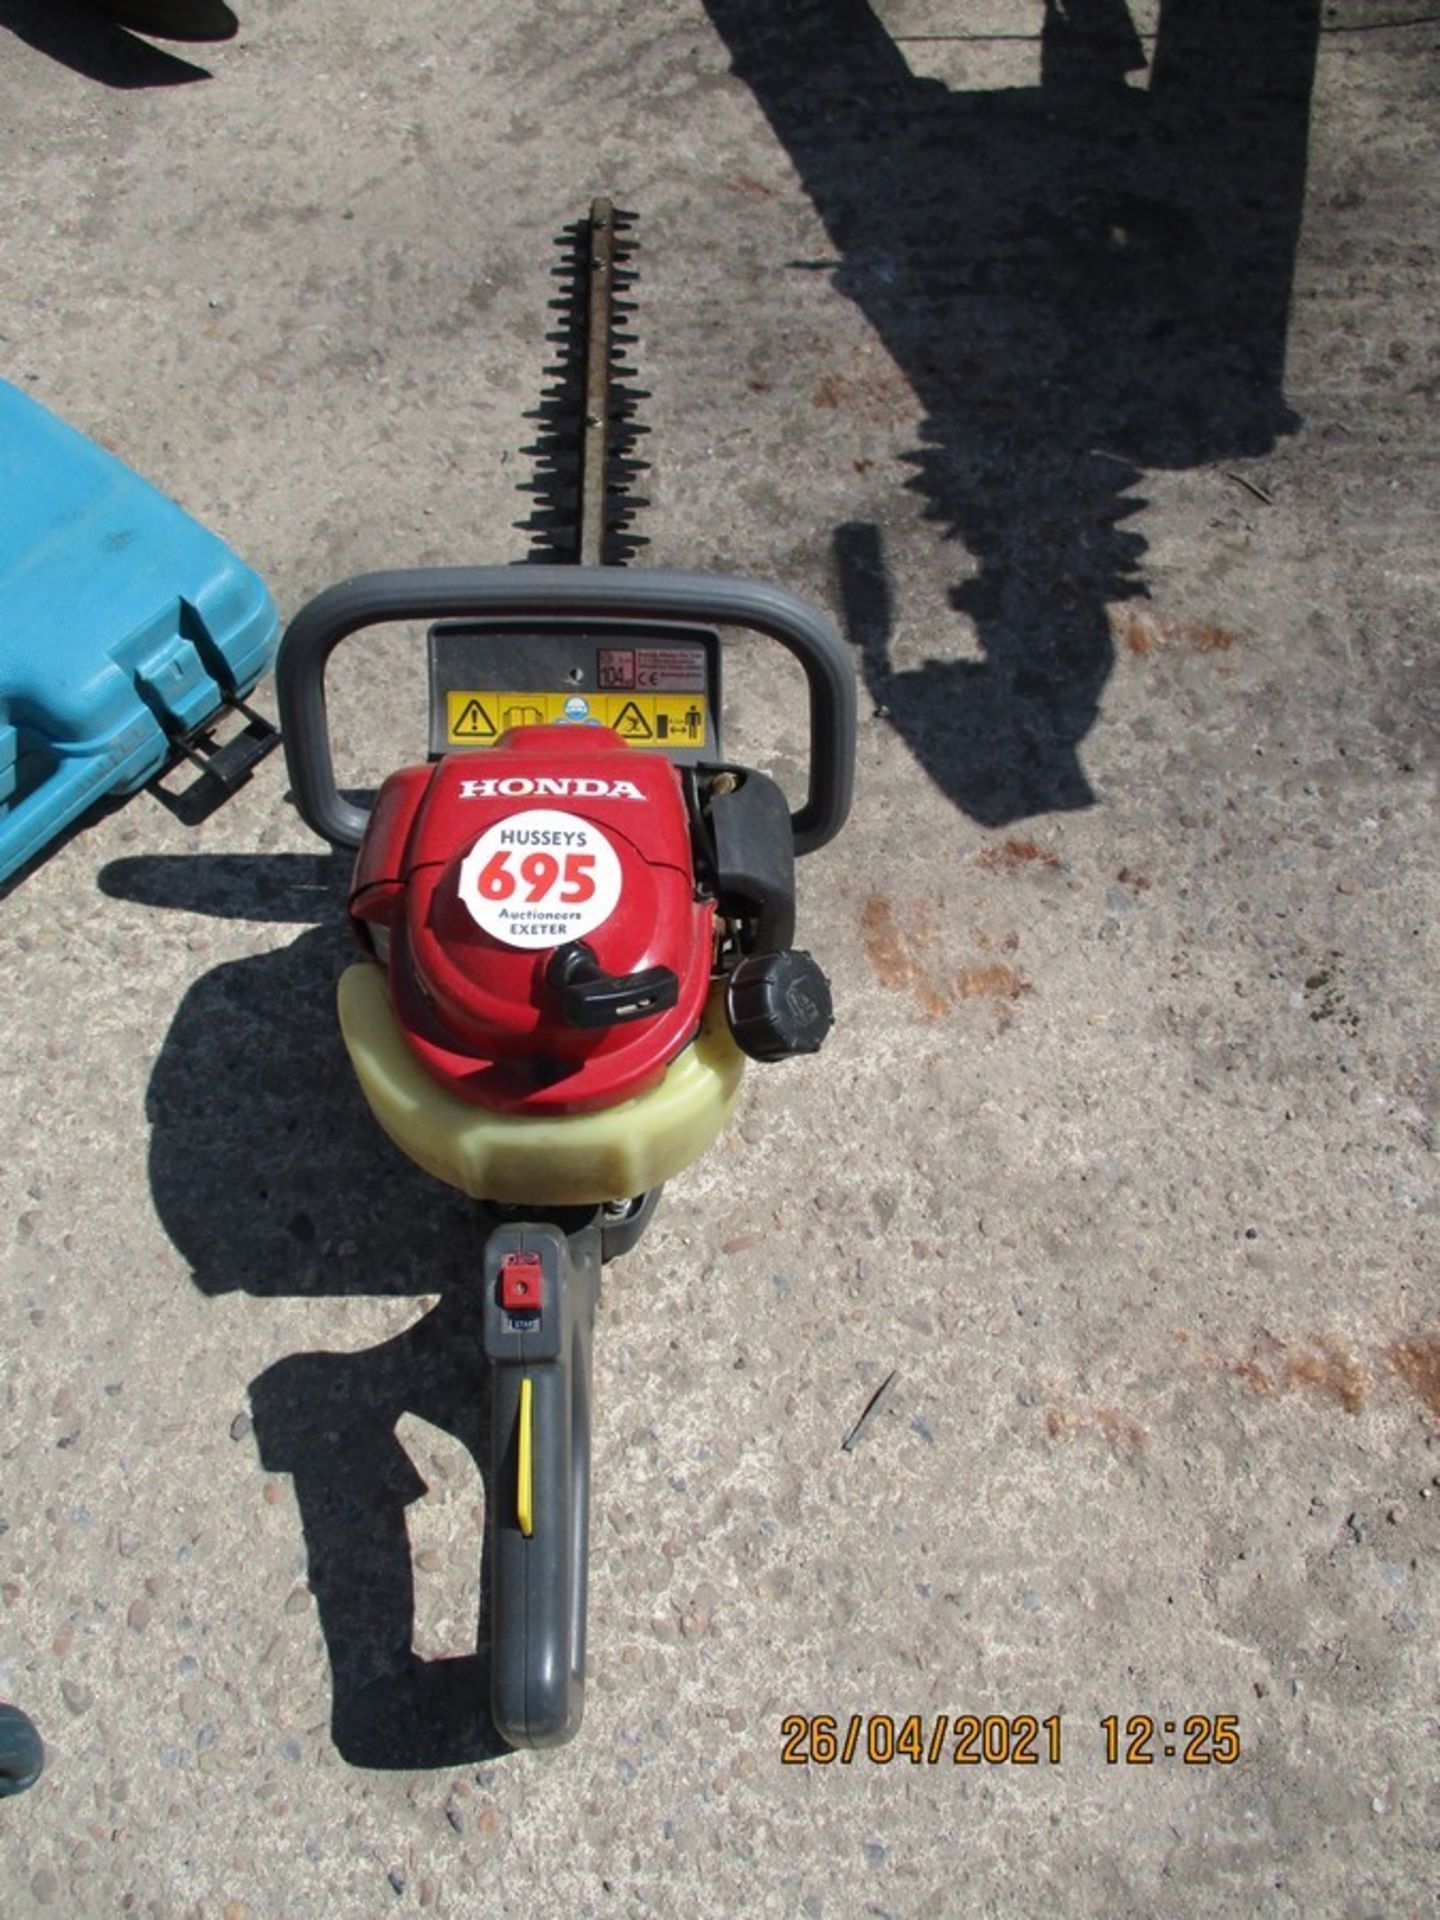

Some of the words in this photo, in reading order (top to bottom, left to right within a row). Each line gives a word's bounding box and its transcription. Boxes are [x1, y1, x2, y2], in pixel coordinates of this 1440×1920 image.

[458, 777, 647, 801] HONDA
[500, 829, 588, 847] HUSSEYS
[477, 850, 597, 904] 695
[498, 908, 582, 921] Auctioneers
[510, 923, 568, 936] EXETER
